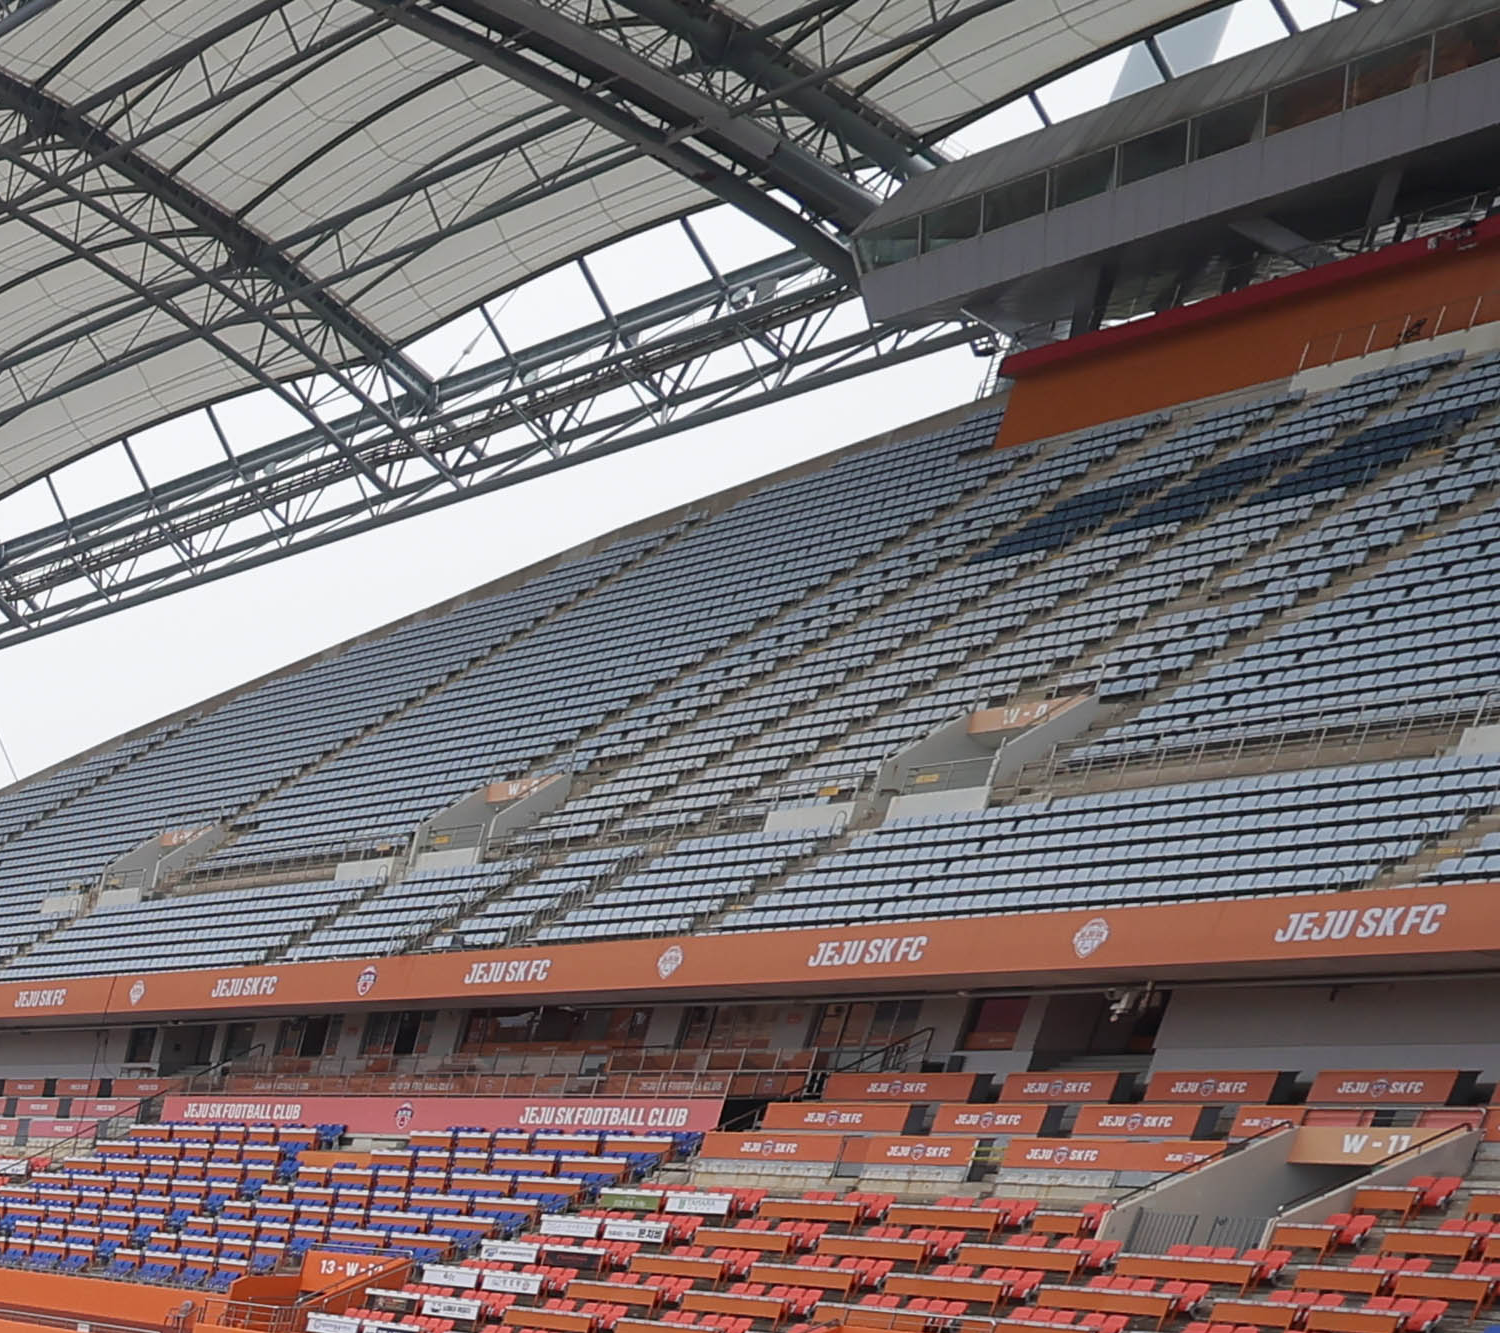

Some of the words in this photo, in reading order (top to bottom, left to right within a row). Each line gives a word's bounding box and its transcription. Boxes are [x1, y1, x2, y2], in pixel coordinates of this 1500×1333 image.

[1275, 908, 1358, 942] JEJU
[1355, 907, 1404, 938] SK
[1400, 903, 1447, 935] FC
[808, 941, 867, 967] JEJU
[864, 938, 899, 963] SK
[896, 936, 928, 961] FC
[464, 962, 507, 983] JEJU
[505, 960, 529, 981] SK
[527, 959, 550, 981] FC
[212, 978, 245, 997] JEJU
[243, 976, 262, 996] SK
[260, 975, 278, 995] FC
[14, 991, 40, 1007] JEJU
[39, 989, 53, 1006] SK
[52, 989, 66, 1005] FC
[1023, 1082, 1049, 1093] JEJU
[1064, 1082, 1078, 1093] SK
[1077, 1081, 1091, 1093] FC
[1171, 1081, 1198, 1093] JEJU
[1216, 1081, 1232, 1093] SK
[1231, 1081, 1247, 1093] FC
[1337, 1081, 1366, 1093] JEJU
[1389, 1081, 1406, 1093] SK
[1404, 1081, 1423, 1093] FC
[184, 1103, 210, 1119] JEJU
[208, 1103, 222, 1119] SK
[222, 1103, 275, 1120] FOOTBALL
[276, 1104, 301, 1120] CLUB
[519, 1107, 556, 1125] JEJU
[555, 1107, 576, 1125] SK
[574, 1107, 645, 1126] FOOTBALL
[647, 1107, 688, 1127] CLUB
[804, 1113, 825, 1124] JEJU
[838, 1113, 851, 1124] SK
[850, 1113, 863, 1124] FC
[955, 1114, 978, 1125] JEJU
[995, 1114, 1008, 1125] SK
[1007, 1114, 1021, 1125] FC
[1098, 1115, 1125, 1127] JEJU
[1143, 1115, 1158, 1127] SK
[1157, 1115, 1172, 1127] FC
[740, 1142, 761, 1153] JEJU
[774, 1142, 786, 1153] SK
[785, 1142, 797, 1153] FC
[1342, 1133, 1412, 1154] W-11
[886, 1145, 909, 1157] JEJU
[925, 1146, 939, 1157] SK
[938, 1146, 951, 1158] FC
[1026, 1148, 1052, 1160] JEJU
[1068, 1150, 1083, 1161] SK
[1082, 1149, 1098, 1161] FC
